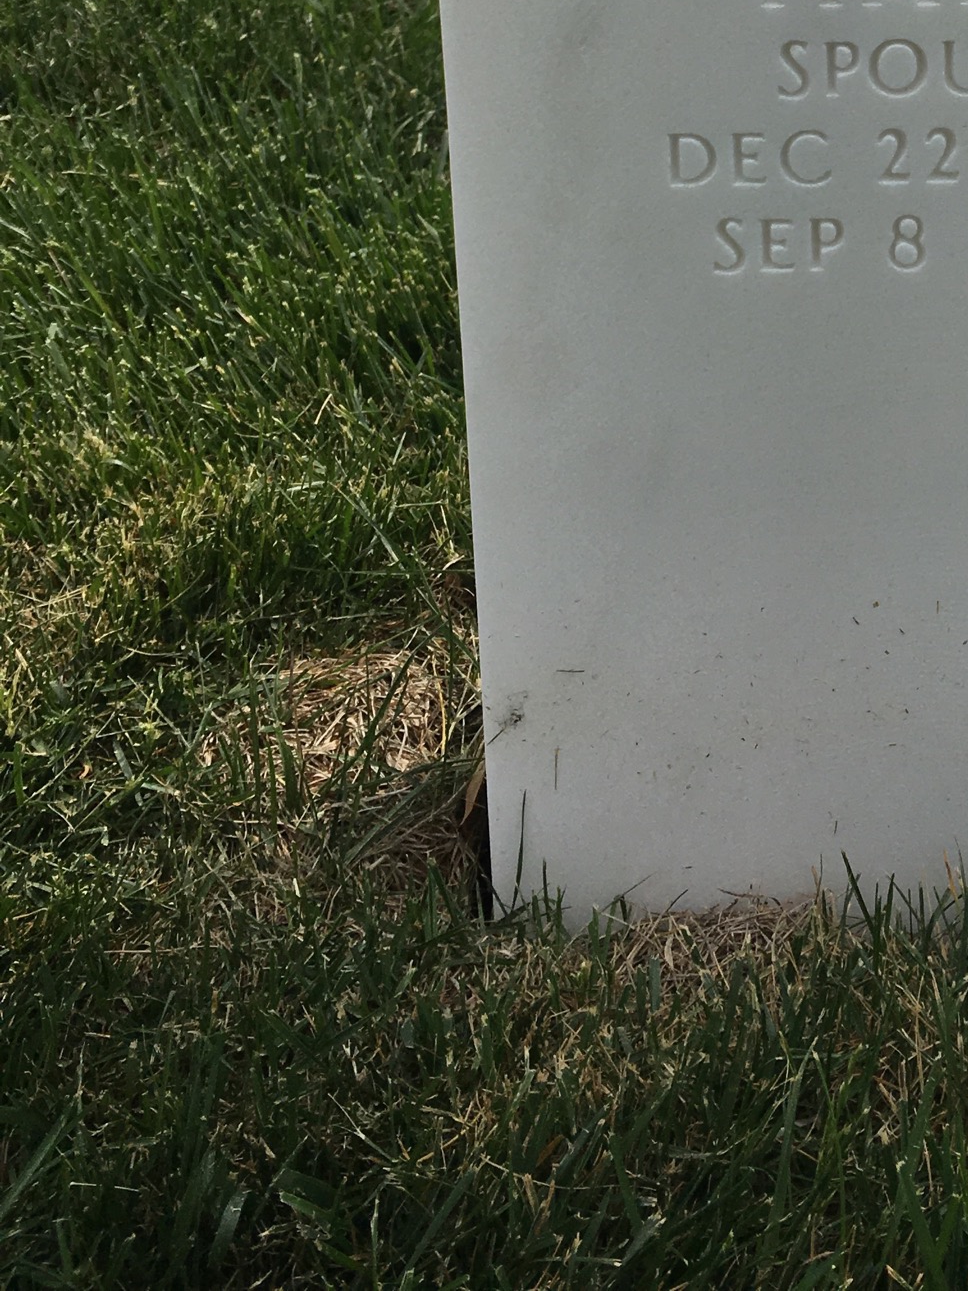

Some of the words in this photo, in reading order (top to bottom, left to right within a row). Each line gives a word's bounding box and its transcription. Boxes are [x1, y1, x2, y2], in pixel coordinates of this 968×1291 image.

[667, 130, 832, 187] DEC
[877, 127, 960, 184] 22
[713, 217, 844, 276] SEP
[889, 214, 927, 272] 8
